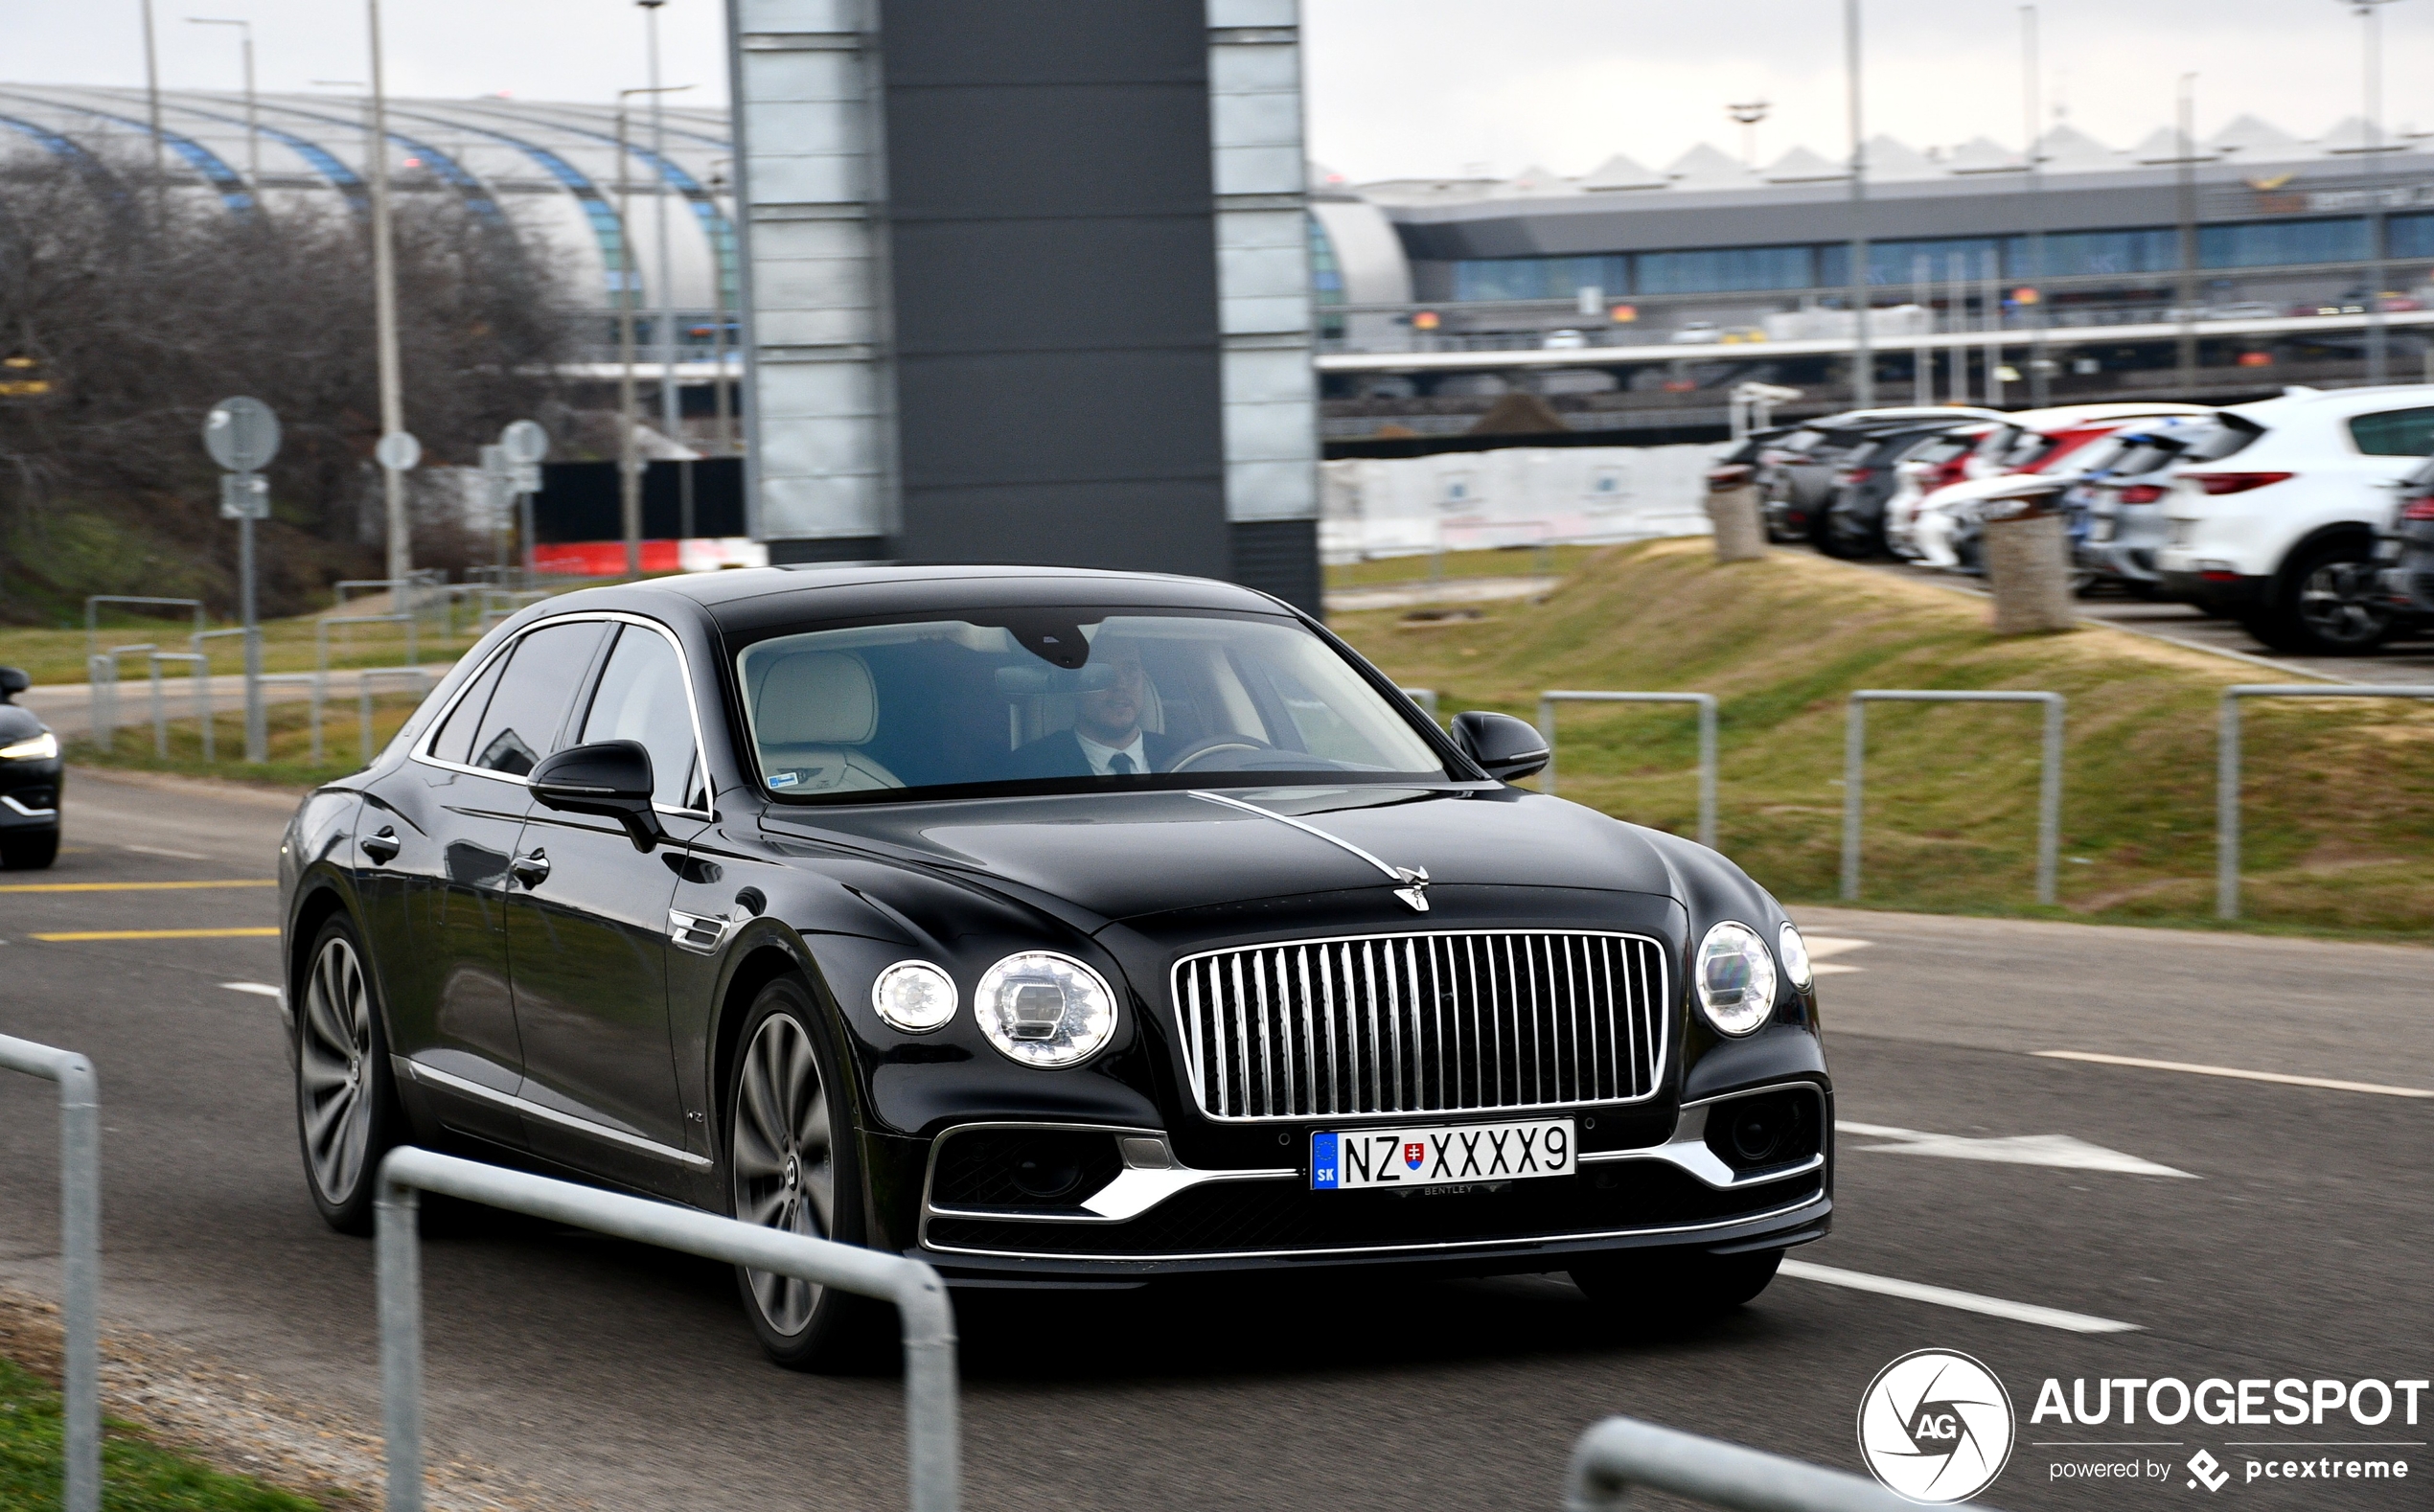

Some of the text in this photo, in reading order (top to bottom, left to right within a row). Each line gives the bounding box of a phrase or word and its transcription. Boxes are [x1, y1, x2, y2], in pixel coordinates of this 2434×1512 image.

[1345, 1126, 1568, 1183] NZ XXXX9
[1318, 1168, 1335, 1181] SK
[1425, 1184, 1474, 1196] BENTLEY
